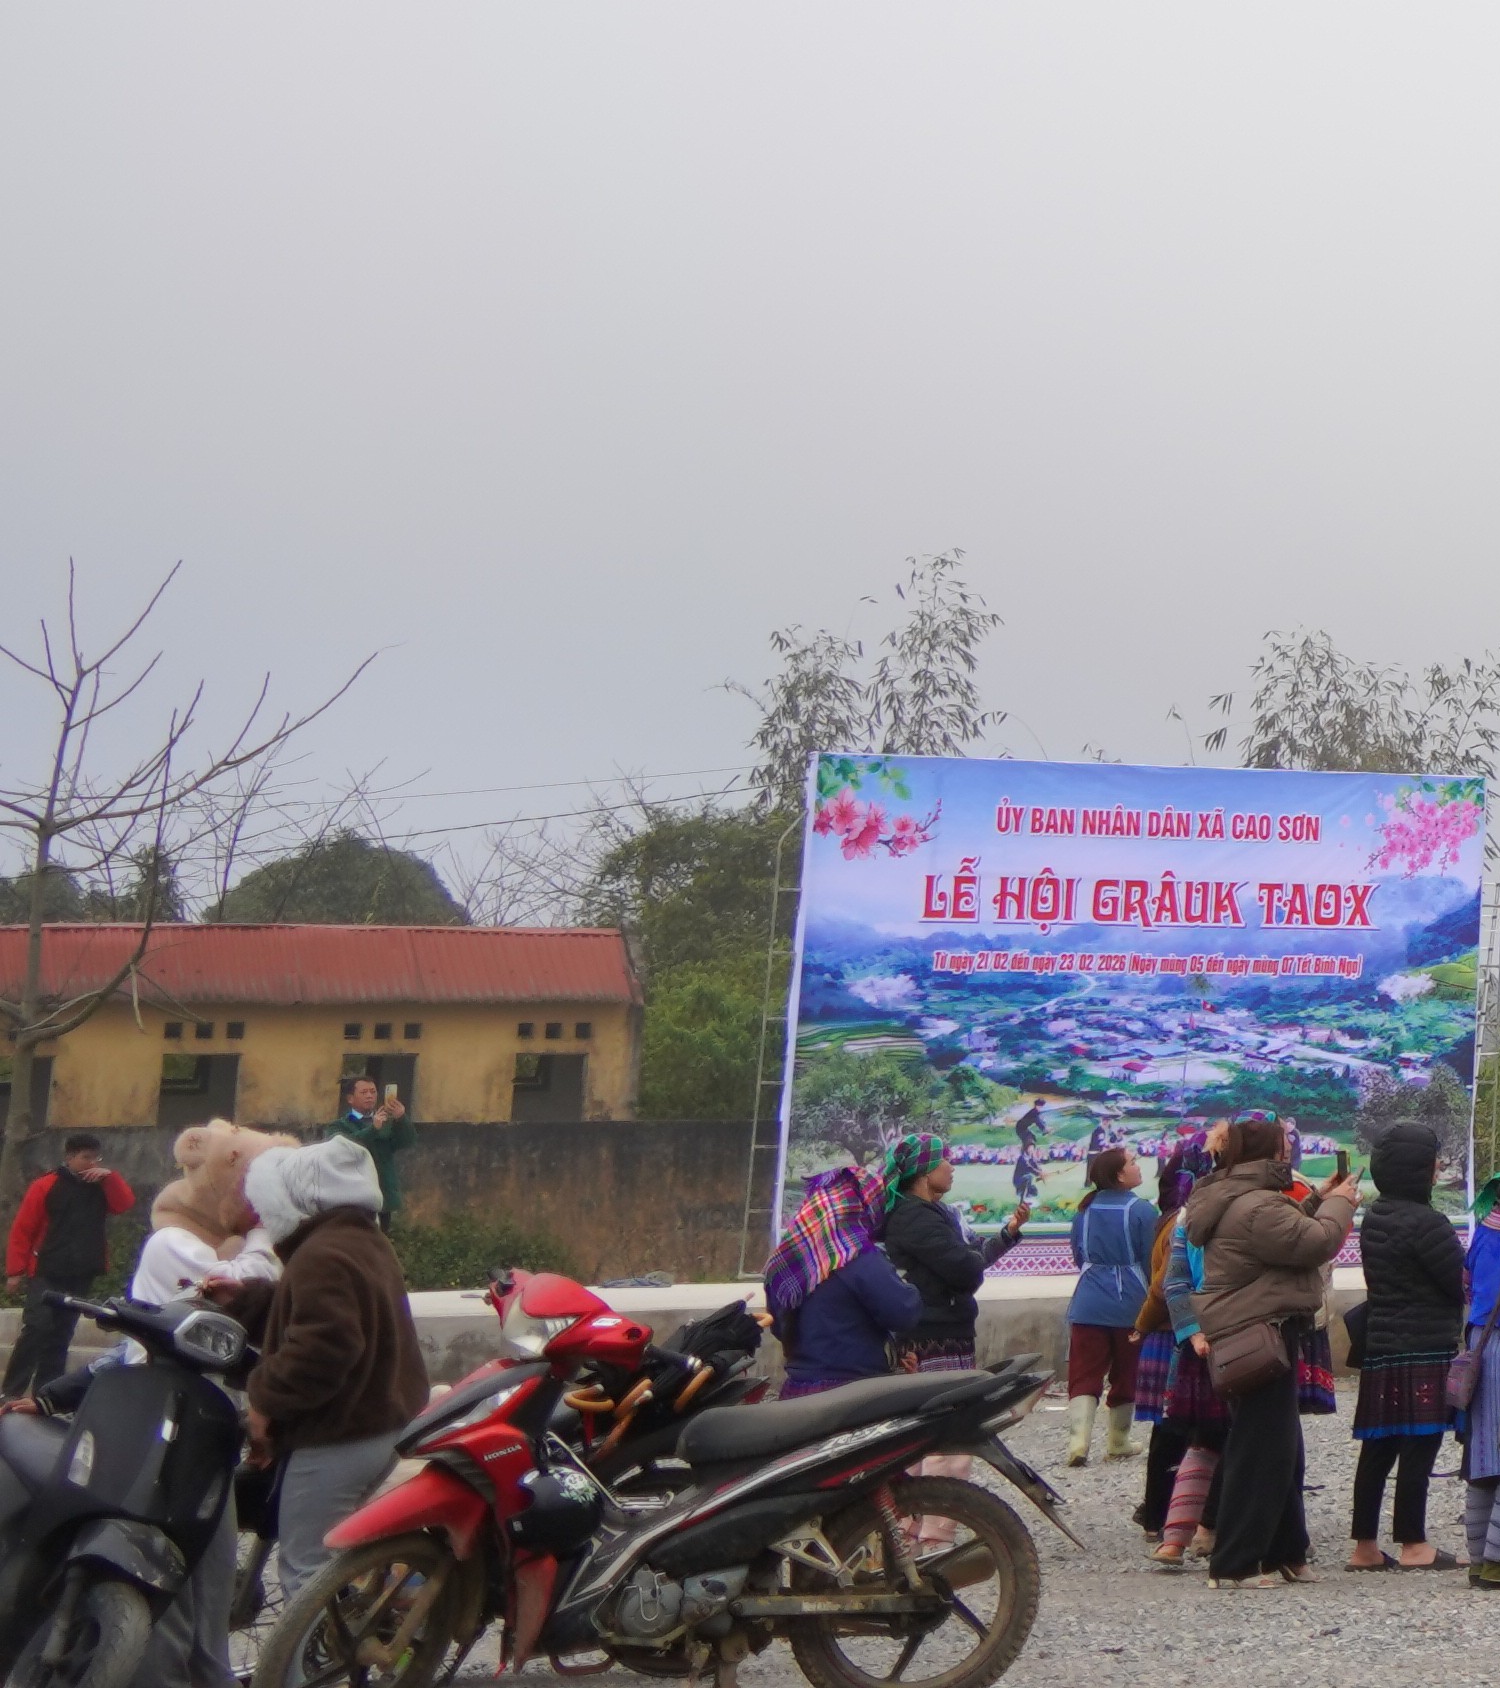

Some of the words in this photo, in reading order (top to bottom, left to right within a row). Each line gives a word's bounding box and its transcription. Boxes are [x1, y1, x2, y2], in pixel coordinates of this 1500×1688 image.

[996, 798, 1025, 834] ỦY
[1030, 807, 1075, 835] BAN
[1081, 803, 1142, 837] NHÂN
[1147, 806, 1191, 838] DÂN
[1196, 807, 1225, 840] XÃ
[1231, 813, 1272, 841] CAO
[1277, 813, 1321, 842] SƠN
[920, 856, 981, 923] LỄ
[993, 867, 1081, 935] HỘI
[1091, 870, 1247, 931] GRÂUK
[1257, 881, 1379, 930] TAOX
[935, 951, 948, 970] Từ
[949, 953, 975, 974] ngày
[1010, 950, 1030, 970] đến
[1032, 952, 1057, 974] ngày
[1160, 954, 1187, 976] mùng
[1189, 955, 1205, 972] 05
[1206, 952, 1224, 973] đến
[1226, 954, 1250, 976] ngày
[1252, 956, 1279, 976] mùng
[1281, 956, 1294, 973] 07
[1296, 953, 1313, 973] Tết
[1314, 955, 1336, 974] Bính
